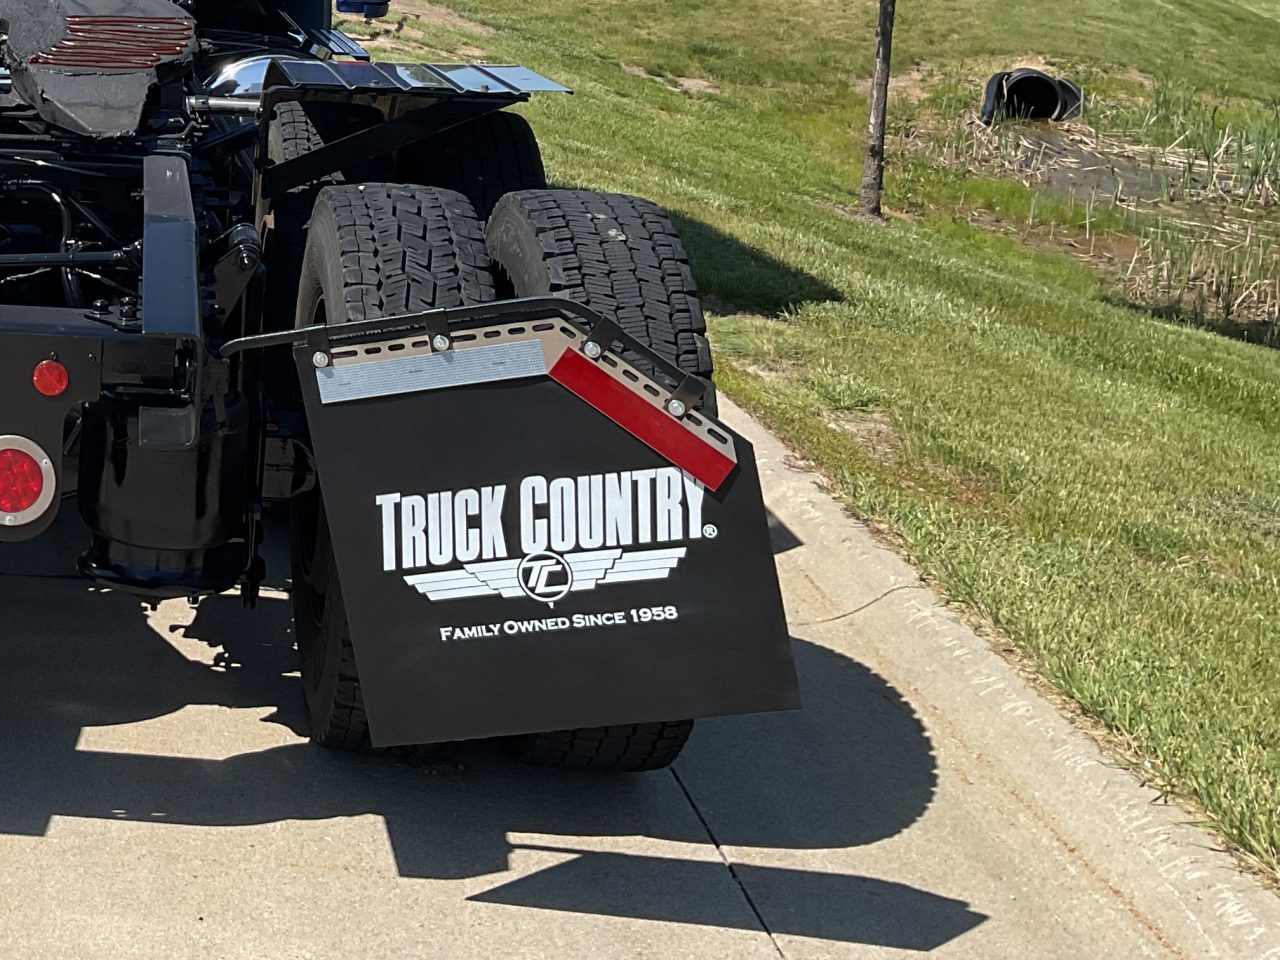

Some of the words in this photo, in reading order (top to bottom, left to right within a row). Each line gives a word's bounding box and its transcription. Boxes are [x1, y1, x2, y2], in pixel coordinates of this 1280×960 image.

[375, 484, 508, 571] TRUCK
[439, 624, 501, 641] FAMILY
[503, 616, 570, 634] OWNED
[572, 611, 626, 627] SINCE
[629, 606, 678, 623] 1958
